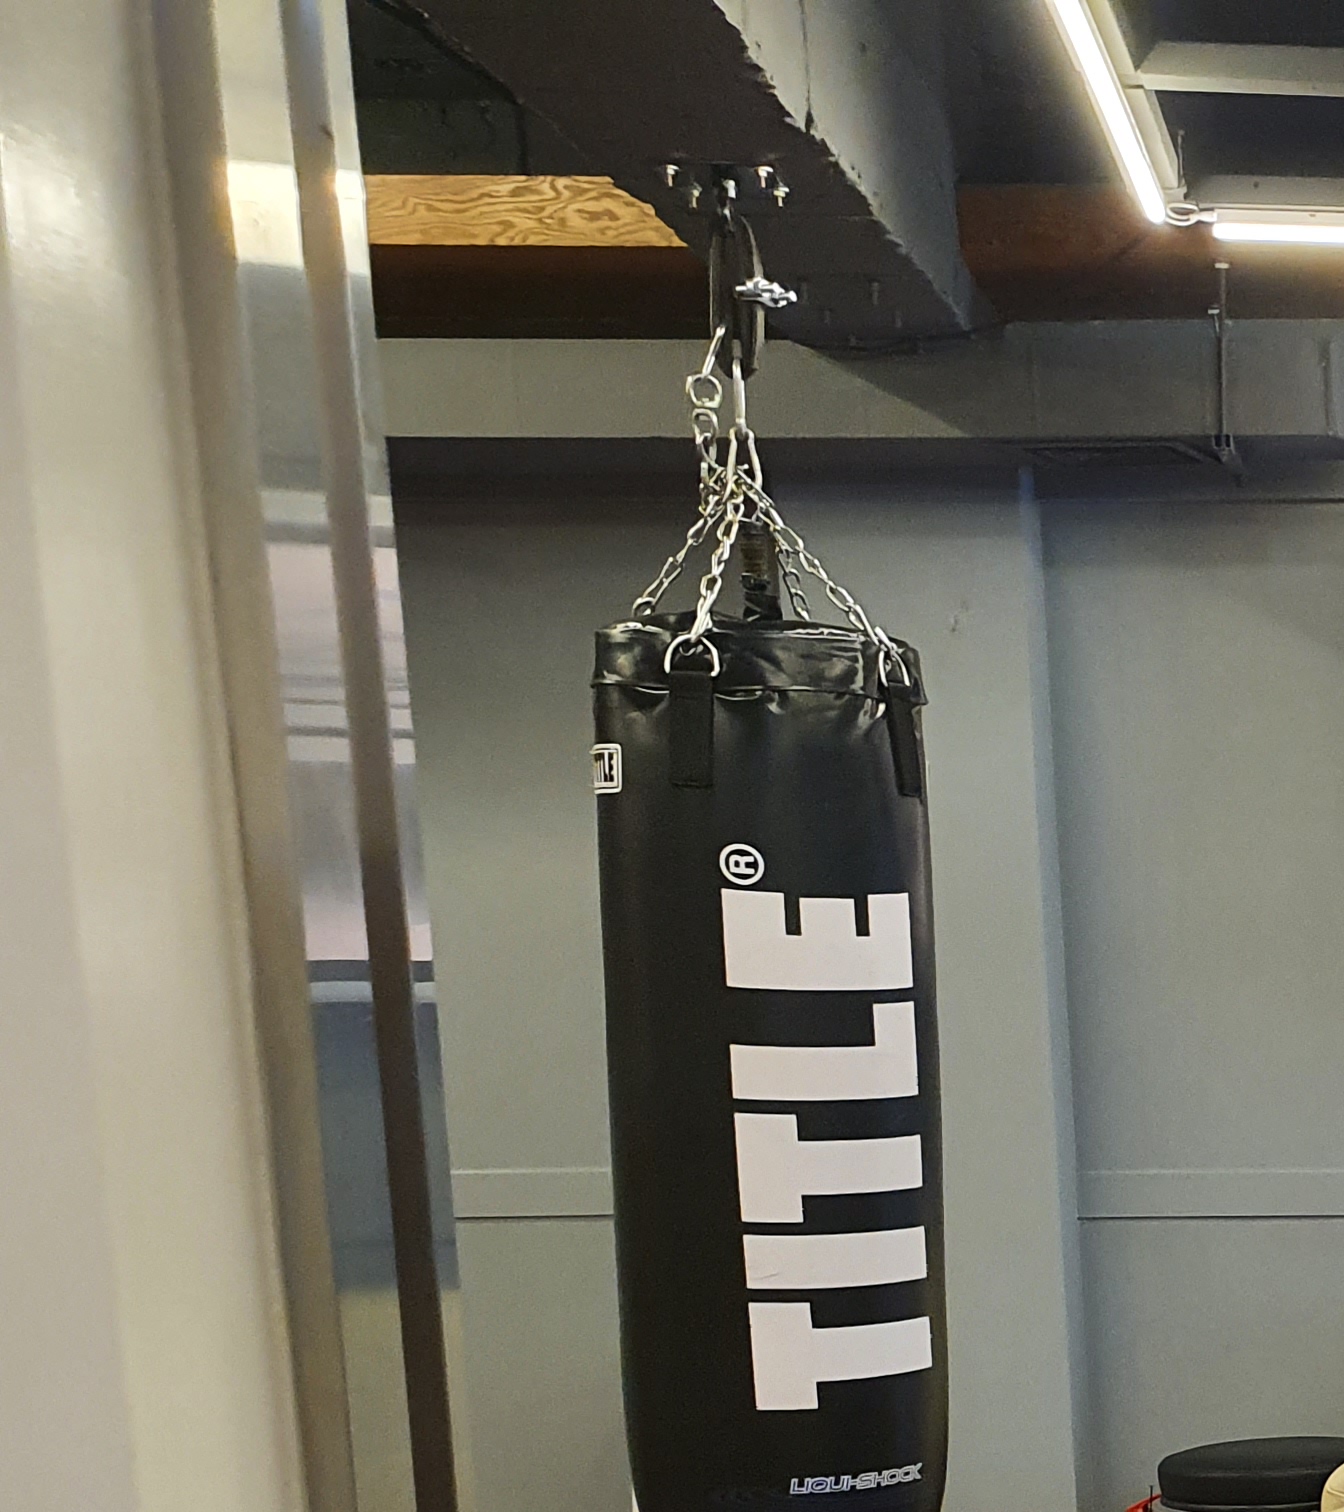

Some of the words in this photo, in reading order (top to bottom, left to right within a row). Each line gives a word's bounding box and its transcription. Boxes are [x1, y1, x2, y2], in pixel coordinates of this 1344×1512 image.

[594, 751, 614, 783] TLE
[721, 888, 933, 1411] TITLE
[789, 1462, 923, 1494] LIQUI-SHOCK
